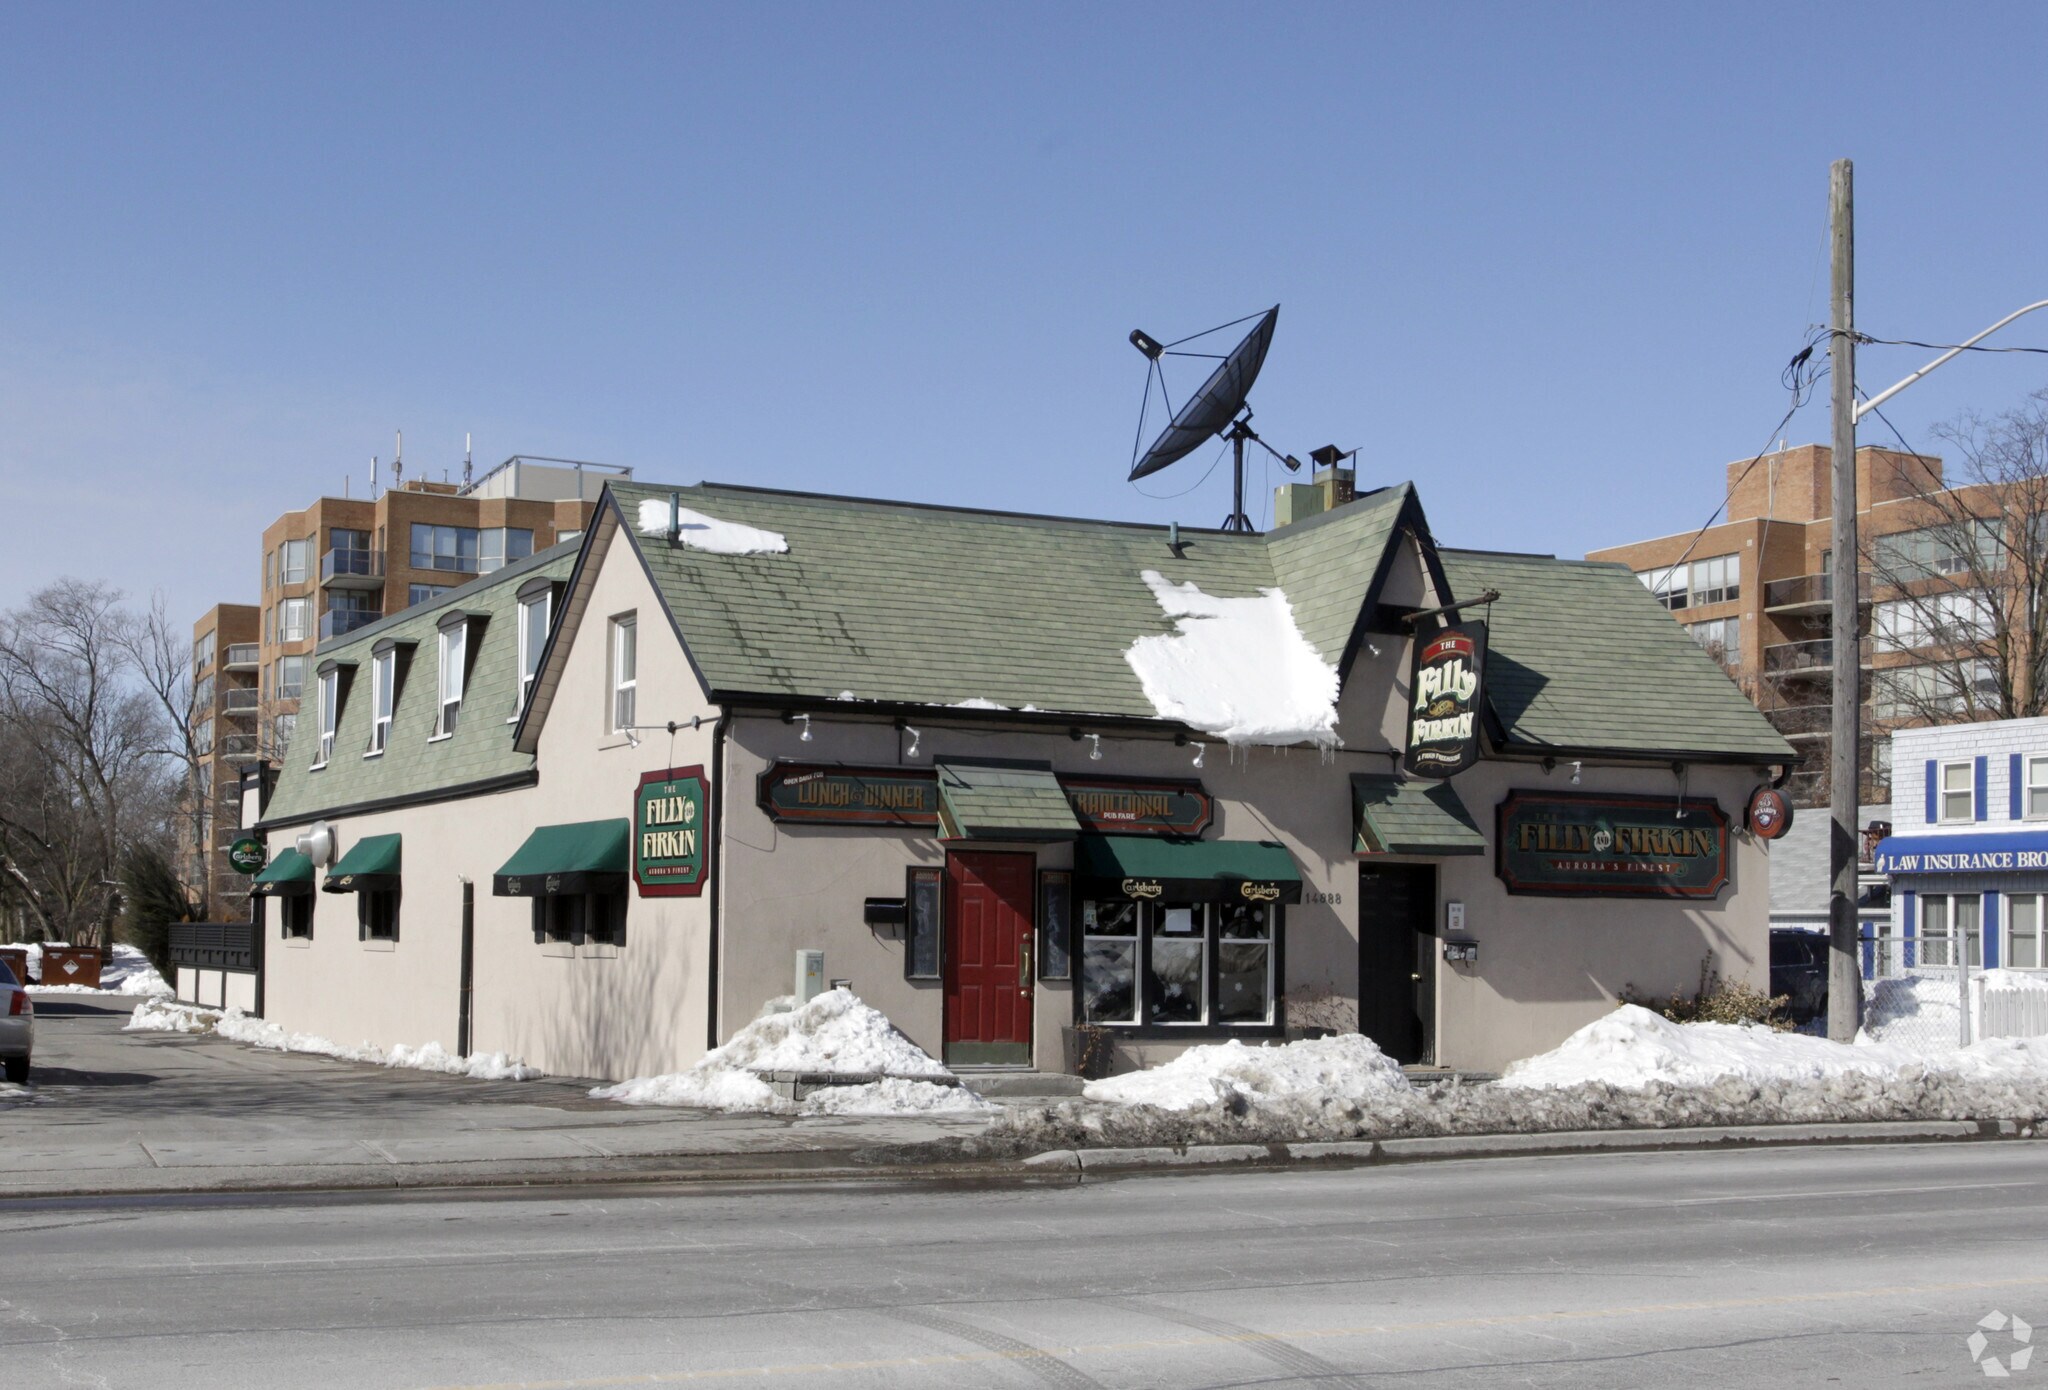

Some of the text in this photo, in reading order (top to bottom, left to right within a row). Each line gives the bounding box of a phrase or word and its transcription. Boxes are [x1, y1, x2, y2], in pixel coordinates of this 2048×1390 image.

[1440, 641, 1456, 650] THE
[1415, 658, 1476, 711] Filly
[1411, 712, 1474, 747] FIRKIN
[663, 785, 677, 794] THE
[799, 782, 849, 806] LUNCH
[864, 784, 925, 810] DINNER
[646, 796, 686, 826] FILLY
[1103, 811, 1136, 820] PUB FARE
[643, 830, 695, 858] FIRKIN
[1519, 823, 1594, 852] FILLY
[1615, 827, 1712, 857] FIRKIN
[232, 851, 262, 864] Carlsberg
[1557, 861, 1671, 873] AURORA'S FINEST
[1888, 851, 2048, 871] LAW INSURANCE BRO
[1122, 879, 1162, 898] Carlsberg
[1240, 882, 1280, 900] Carlsberg
[1305, 893, 1341, 904] 14888
